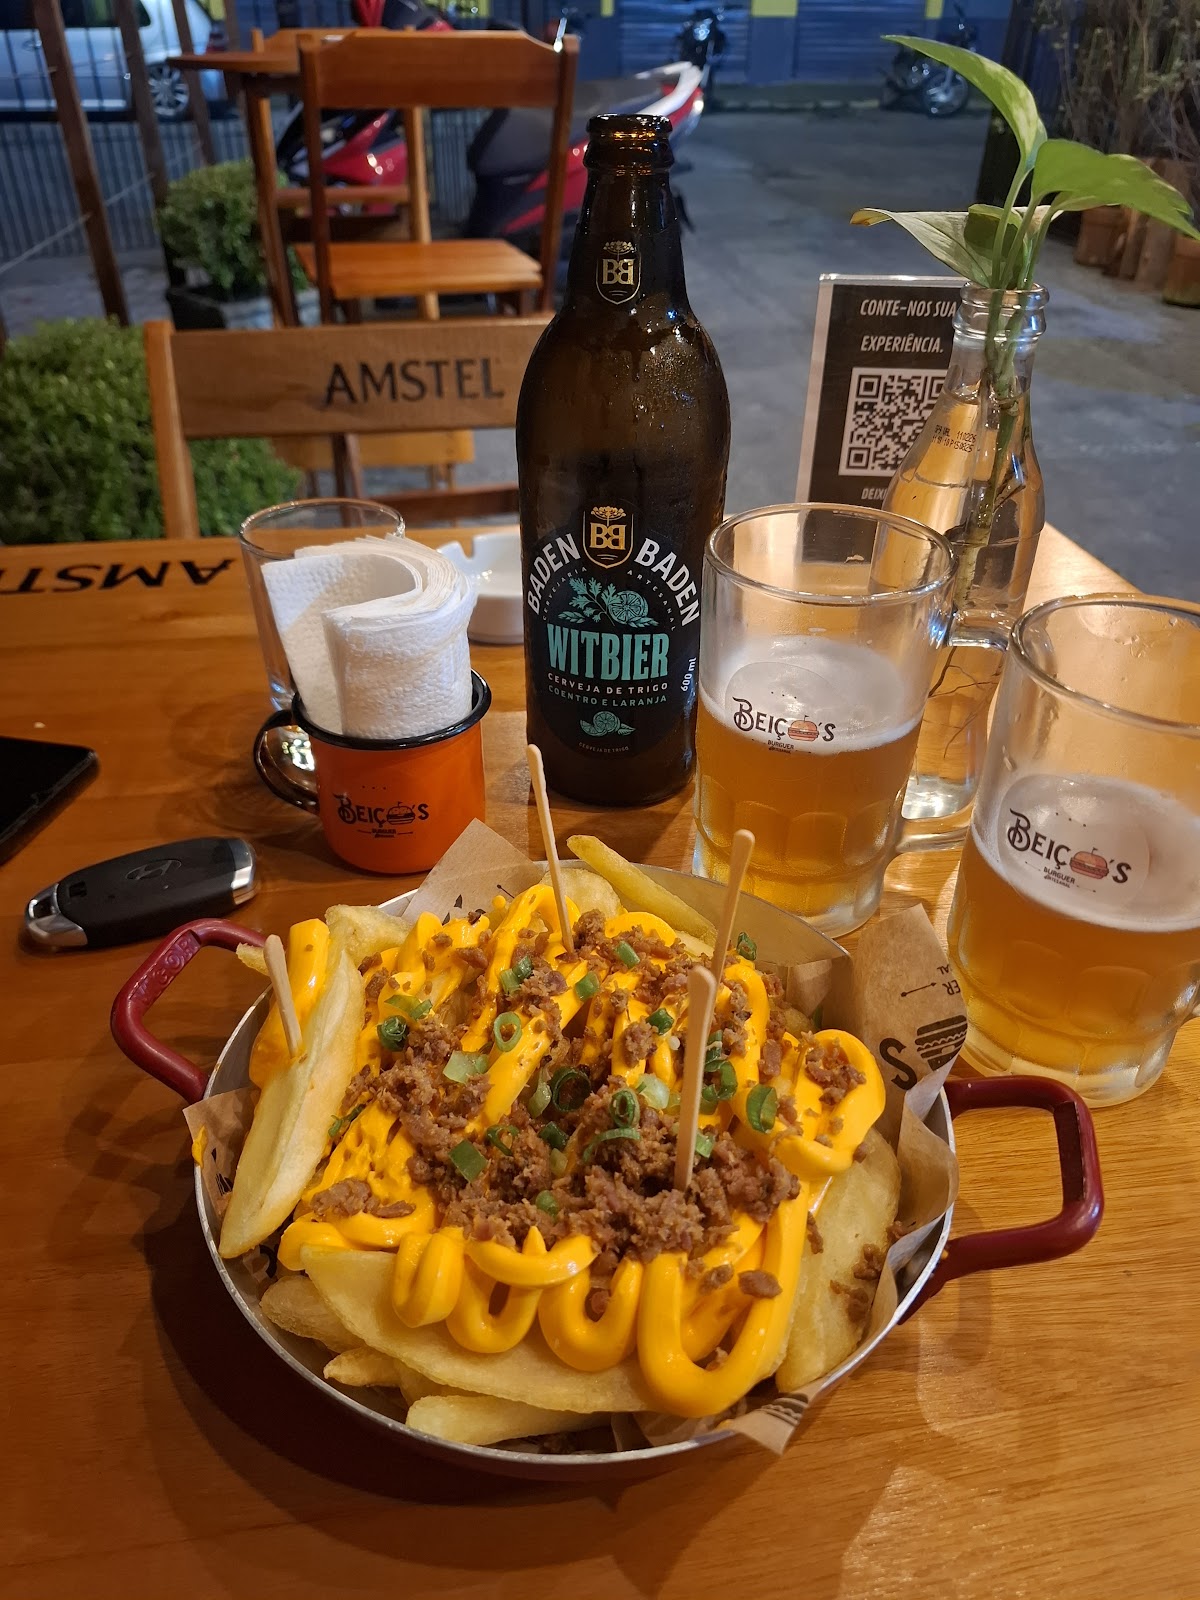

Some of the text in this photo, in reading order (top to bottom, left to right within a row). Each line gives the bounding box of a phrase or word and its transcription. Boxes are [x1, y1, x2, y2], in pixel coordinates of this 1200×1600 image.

[860, 299, 957, 317] CONTE-NOS SUA
[860, 333, 944, 353] EXPERIÊNCIA.
[323, 358, 505, 406] AMSTEL
[0, 559, 236, 595] AMST
[527, 533, 581, 615] BADEN
[634, 538, 700, 627] BADEN
[627, 570, 676, 631] ARTESANAL
[546, 623, 669, 681] WITBIER
[548, 672, 668, 694] CERVEJA DE TRIGO
[548, 685, 598, 705] COENTRO
[612, 695, 667, 707] LARANJA
[681, 673, 693, 692] 600
[1043, 866, 1076, 885] BURGUER
